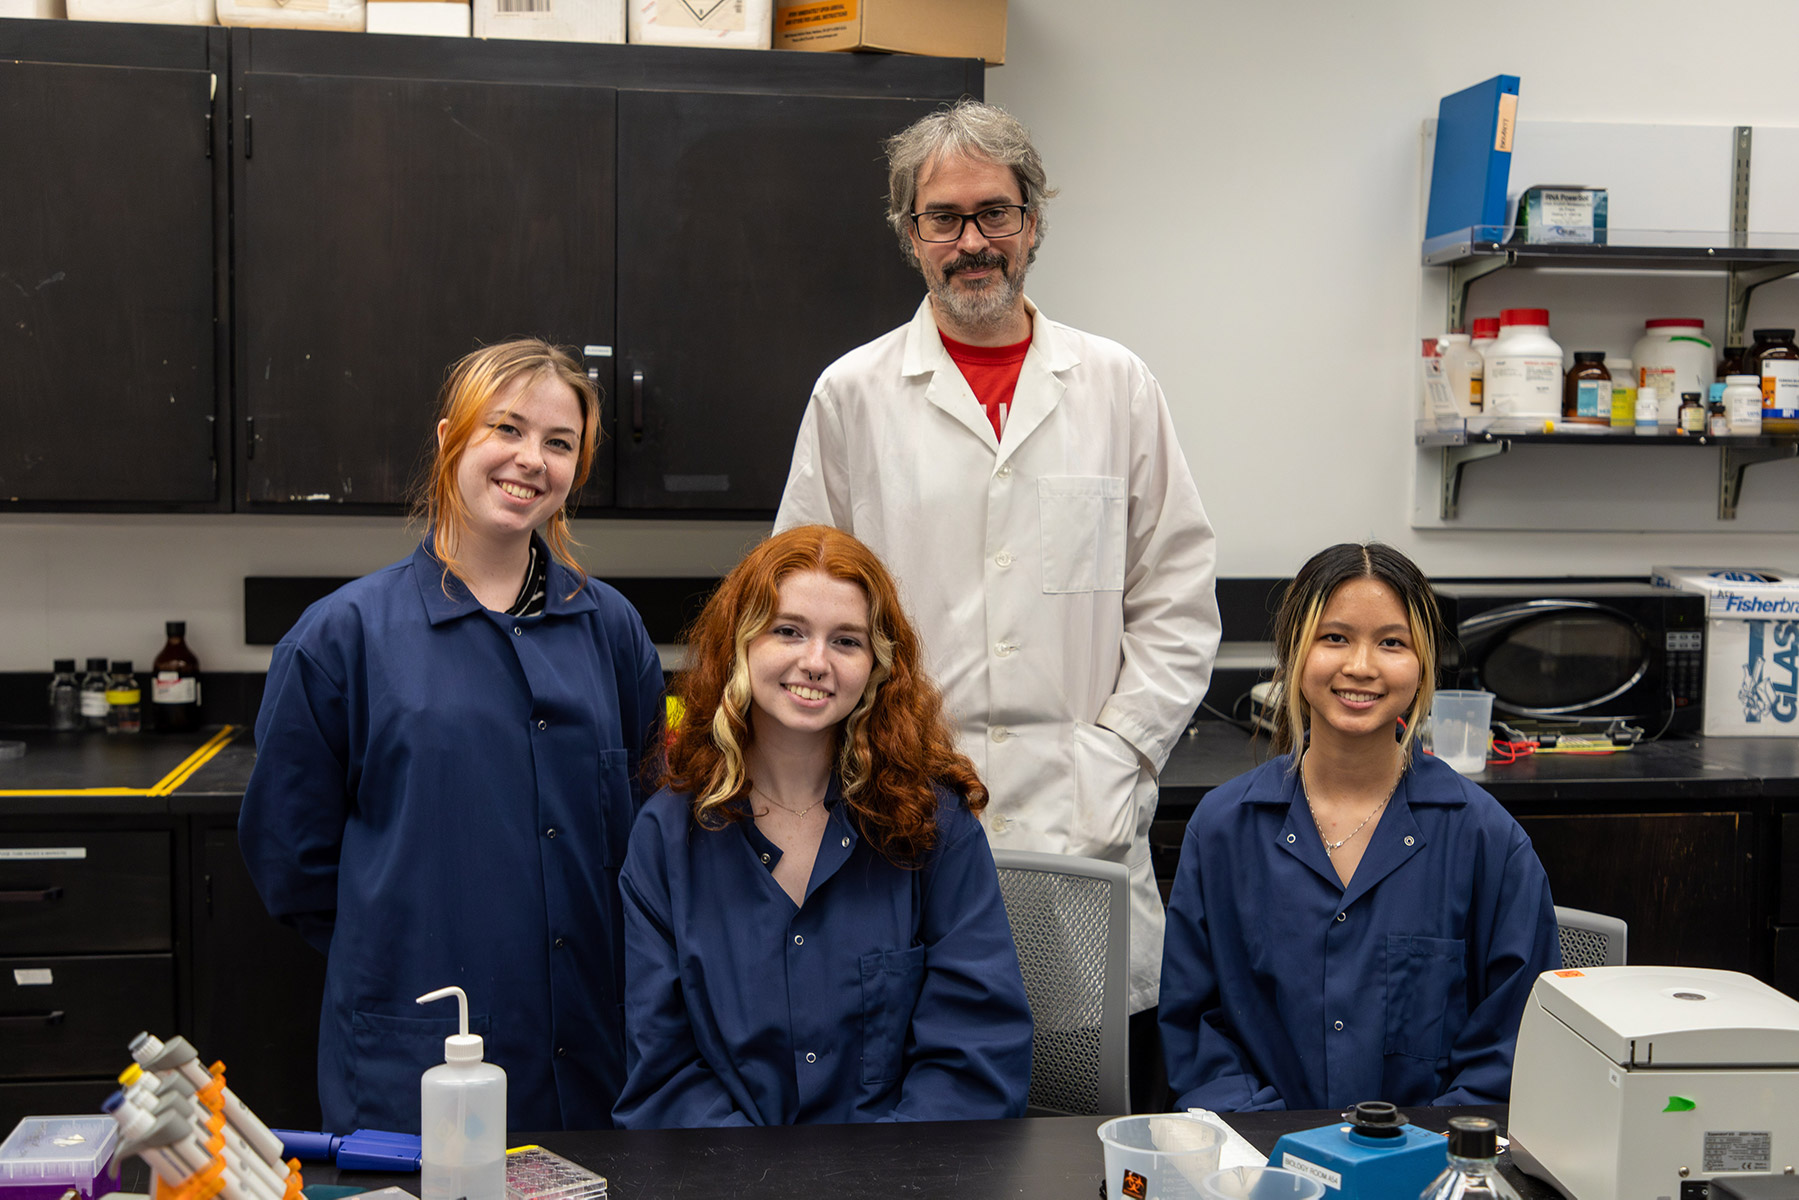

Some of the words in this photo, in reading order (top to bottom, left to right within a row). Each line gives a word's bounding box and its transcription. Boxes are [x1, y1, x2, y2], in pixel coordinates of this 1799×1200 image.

[1545, 193, 1559, 201] RNA
[1771, 619, 1799, 723] GLAS
[1285, 1157, 1309, 1173] BIOLOGY
[1310, 1167, 1328, 1180] ROOM
